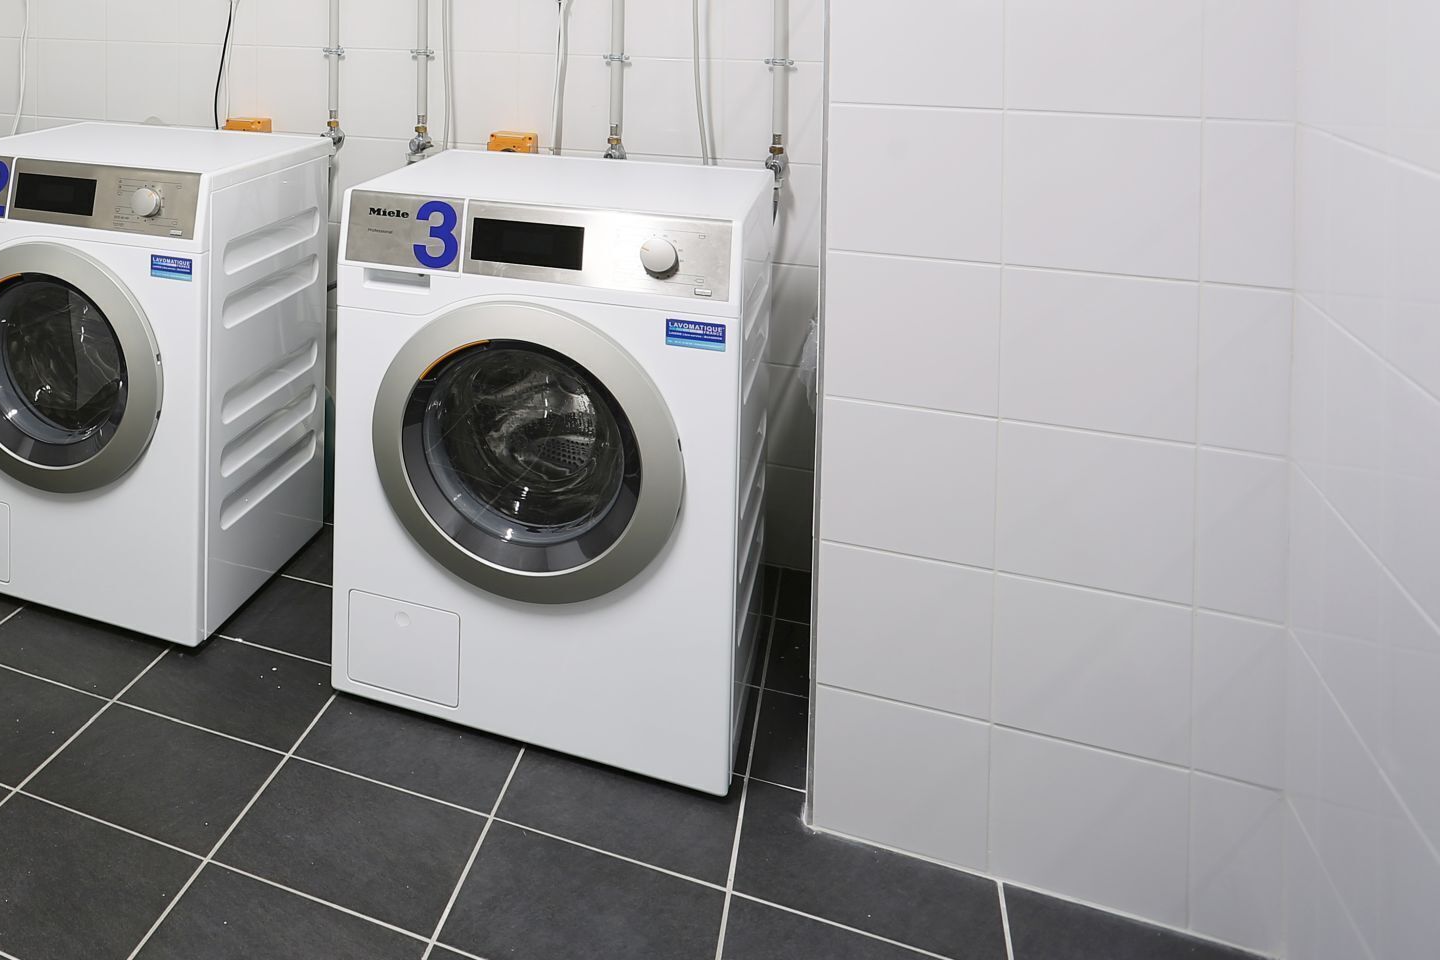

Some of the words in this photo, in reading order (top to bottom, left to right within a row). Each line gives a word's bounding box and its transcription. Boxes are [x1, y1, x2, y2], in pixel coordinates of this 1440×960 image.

[368, 227, 393, 235] Professional
[368, 207, 410, 219] Miele
[413, 200, 459, 269] 3
[152, 256, 190, 266] LAVOMATIQUE
[668, 321, 723, 333] LAVOMATIQUE
